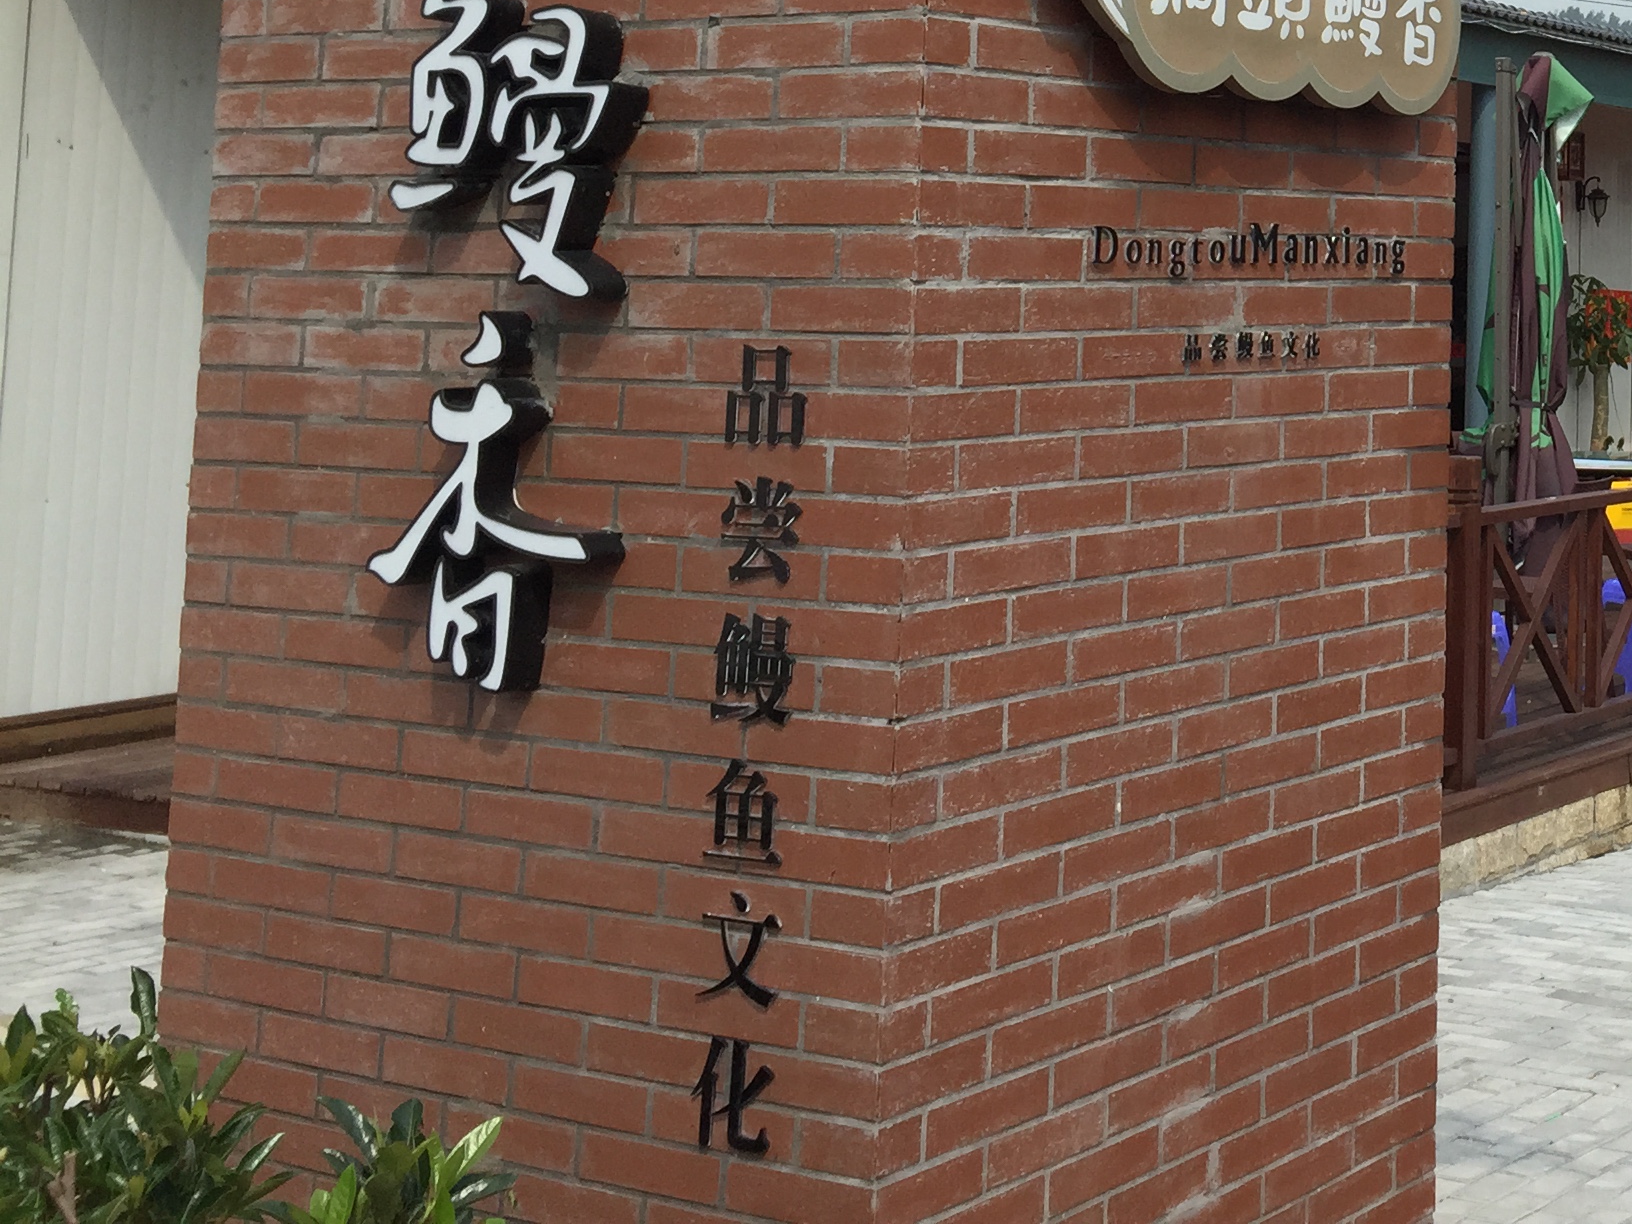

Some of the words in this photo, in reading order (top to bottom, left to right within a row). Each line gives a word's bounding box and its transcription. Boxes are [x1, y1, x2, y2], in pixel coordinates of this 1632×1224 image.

[690, 343, 808, 1156] 品尝鳗鱼文化
